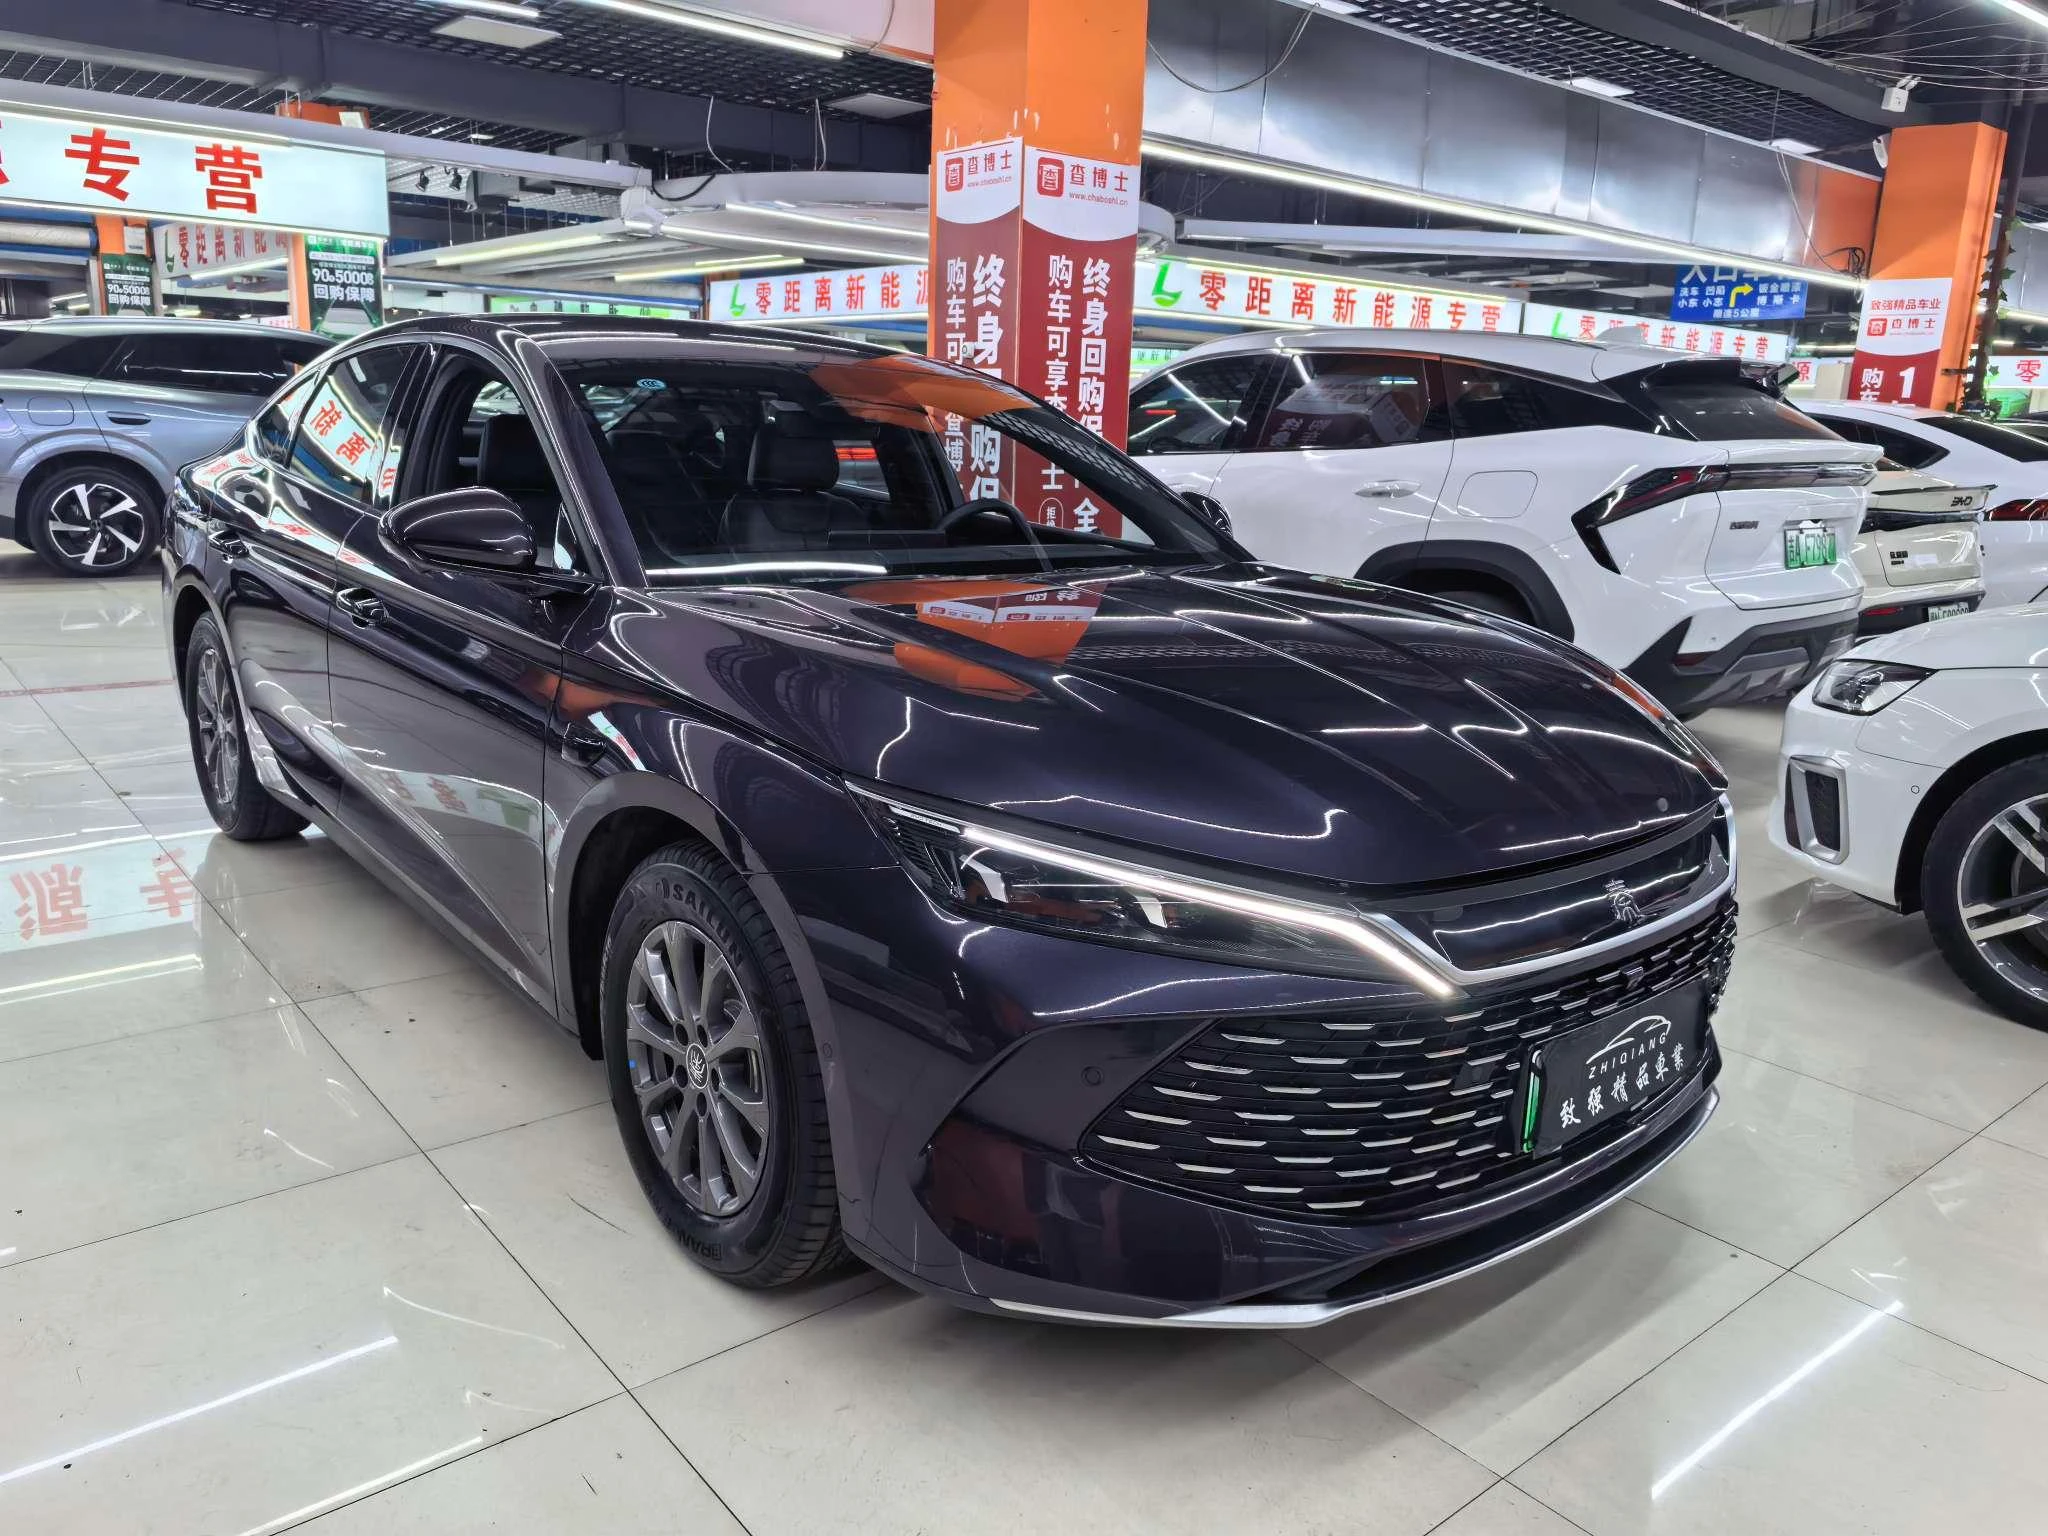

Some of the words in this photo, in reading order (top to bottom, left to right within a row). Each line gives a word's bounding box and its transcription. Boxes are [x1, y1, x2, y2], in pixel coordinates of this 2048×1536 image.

[0, 120, 263, 214] 专营
[968, 150, 1012, 175] 查博士
[1070, 164, 1129, 193] 查博士
[972, 254, 1005, 379] 终身
[1200, 270, 1501, 331] 零距离新能源专营
[1580, 316, 1768, 359] 零新能源专营
[2015, 359, 2042, 382] 零
[1588, 1032, 1667, 1079] ZHIQIANG
